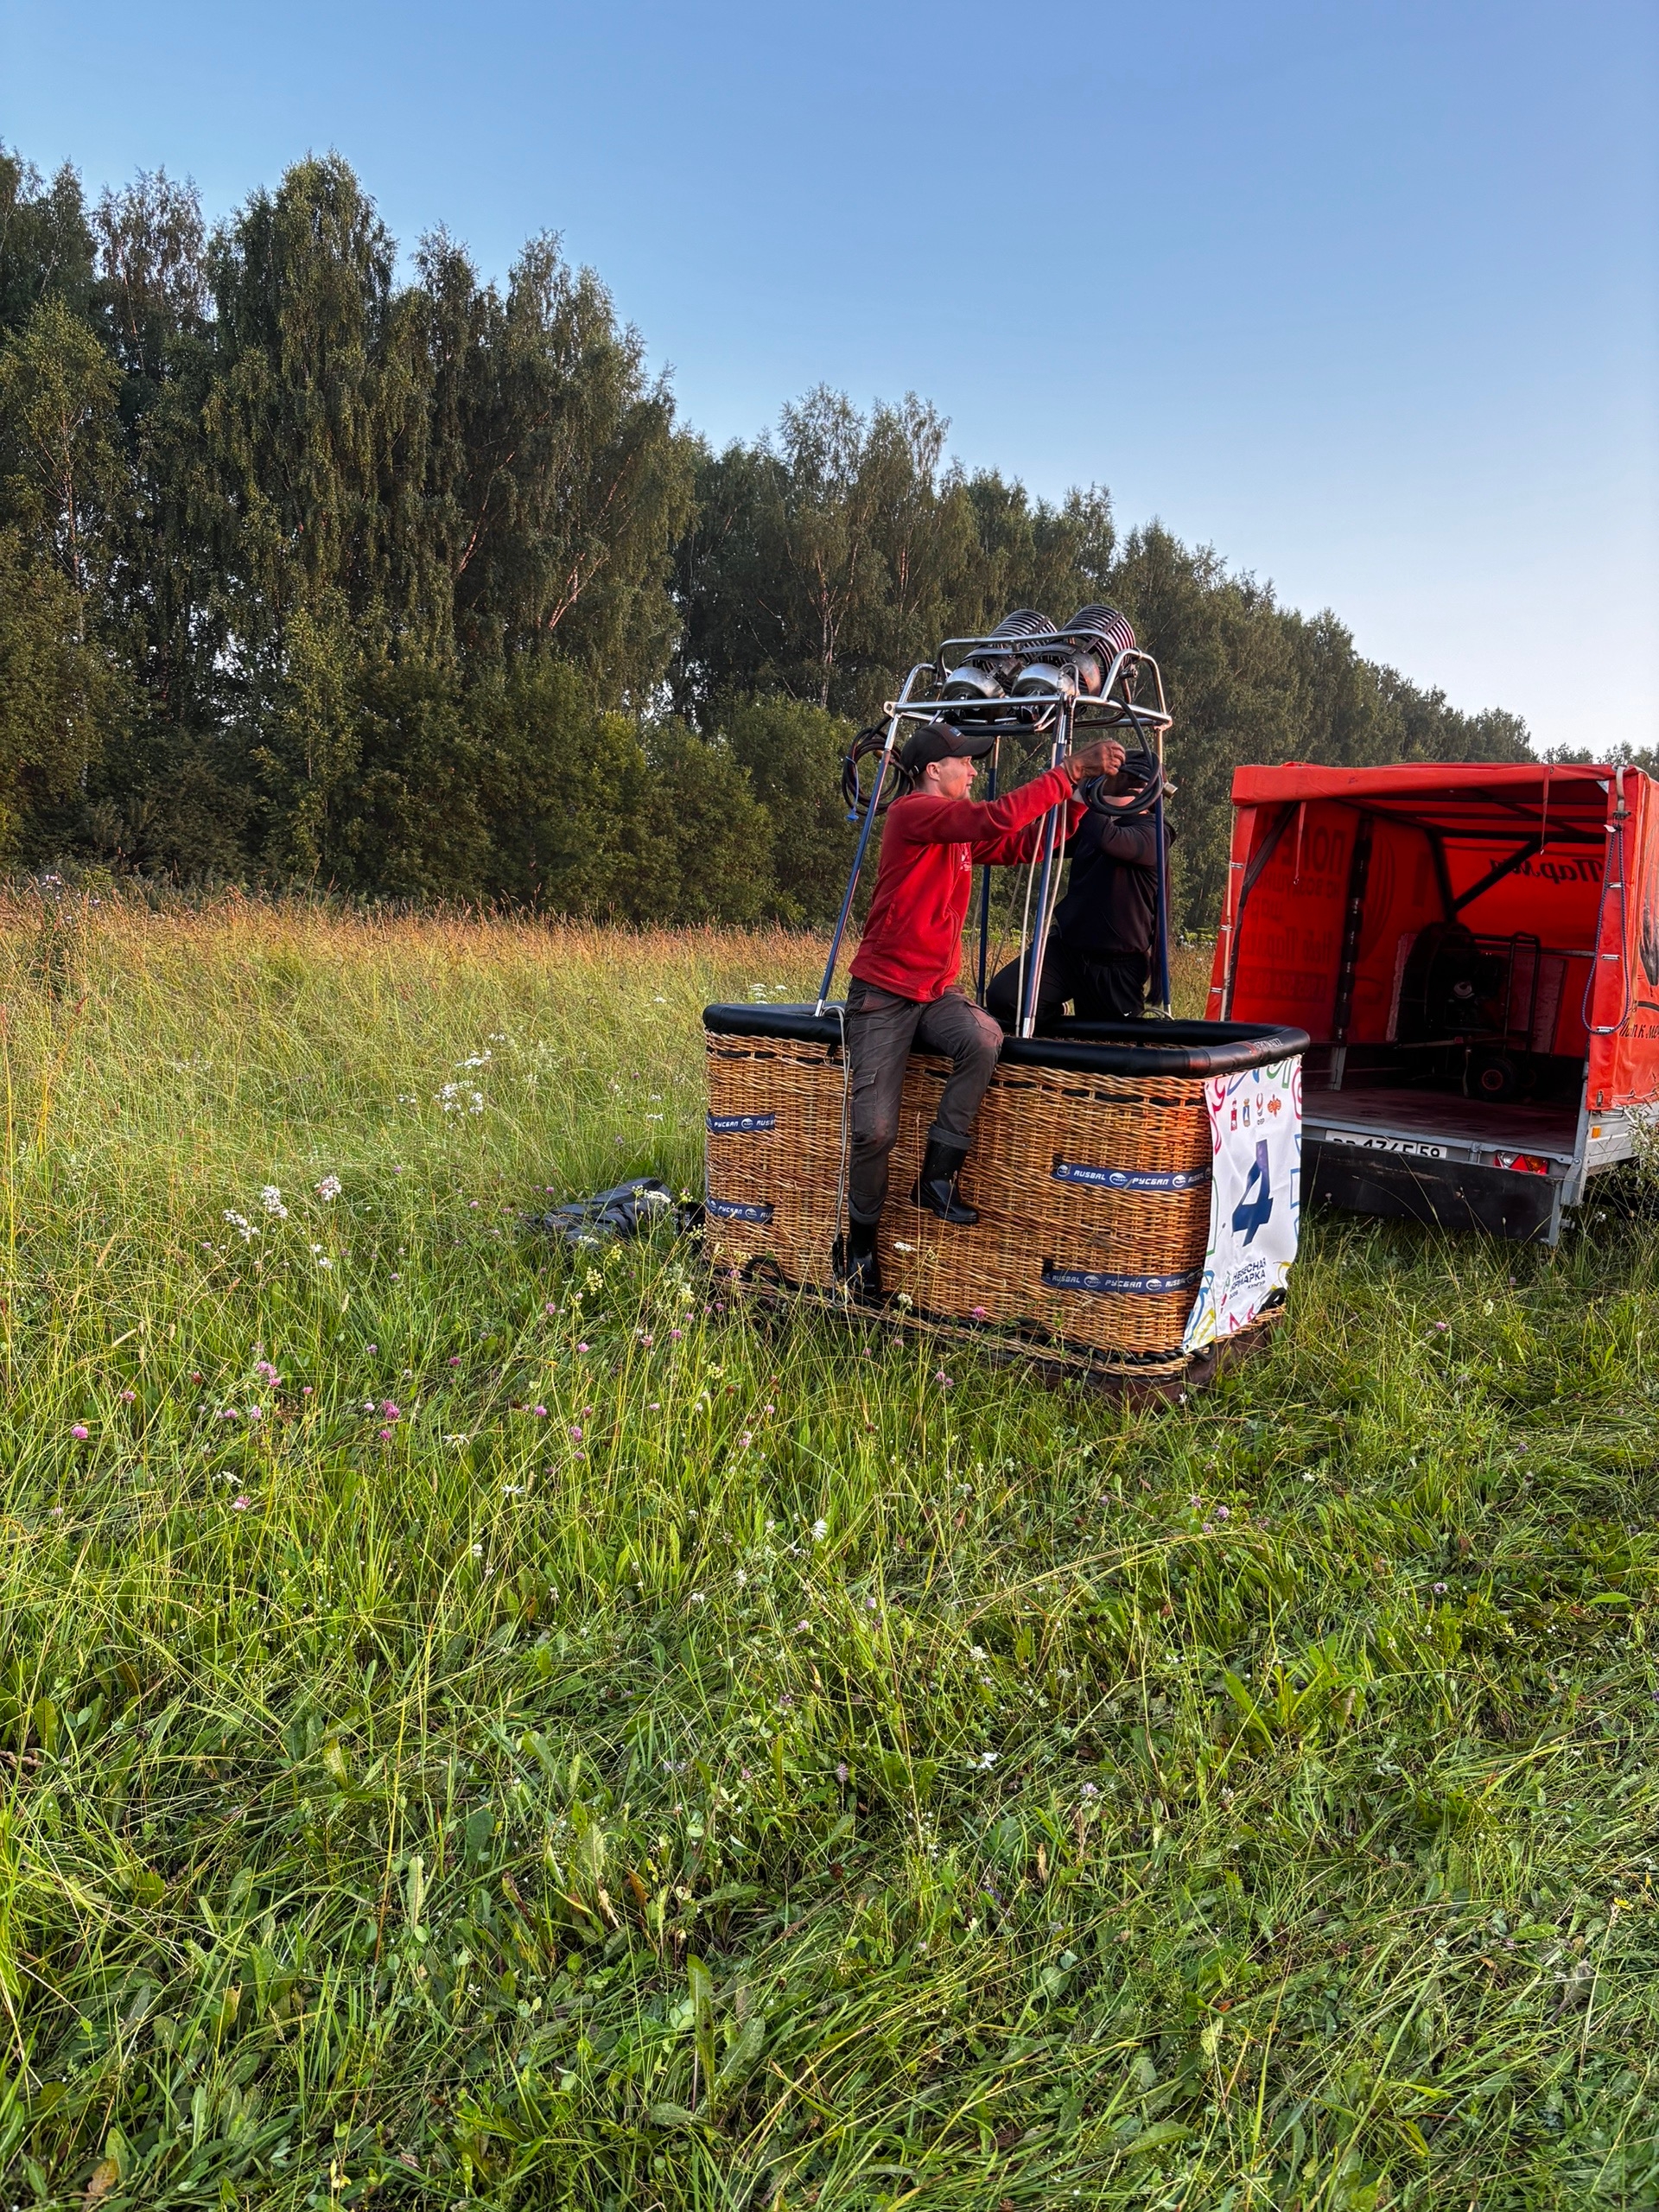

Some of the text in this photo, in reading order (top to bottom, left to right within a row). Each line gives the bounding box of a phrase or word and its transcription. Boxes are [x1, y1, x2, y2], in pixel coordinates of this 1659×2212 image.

[1073, 1170, 1106, 1180] RUSBAL
[1132, 1177, 1170, 1185] РУСБАЛ
[1231, 1139, 1274, 1247] 4
